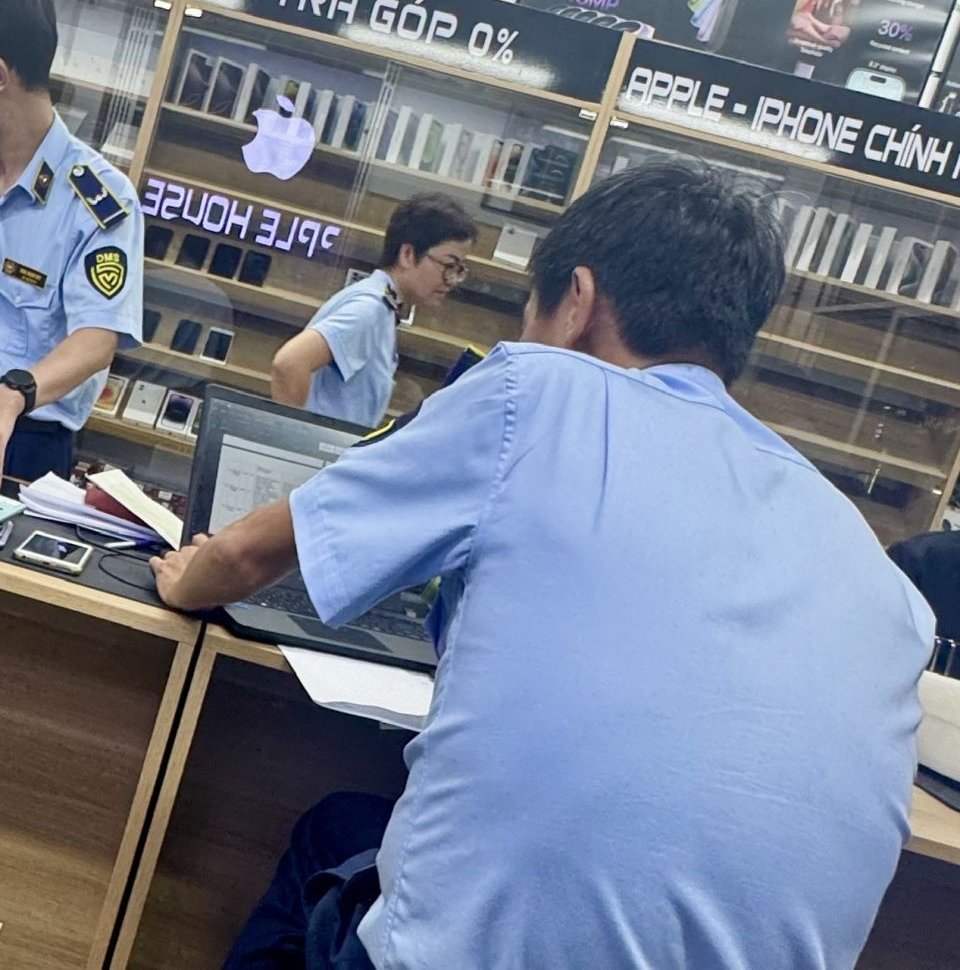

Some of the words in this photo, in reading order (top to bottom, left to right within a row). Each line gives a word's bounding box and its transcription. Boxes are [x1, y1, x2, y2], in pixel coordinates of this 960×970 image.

[468, 22, 519, 65] 0%
[878, 20, 913, 41] 30%
[625, 66, 730, 122] APPLE
[732, 102, 748, 115] -
[751, 95, 864, 154] IPHONE
[865, 123, 954, 177] CHÍNH
[96, 252, 120, 264] DMS
